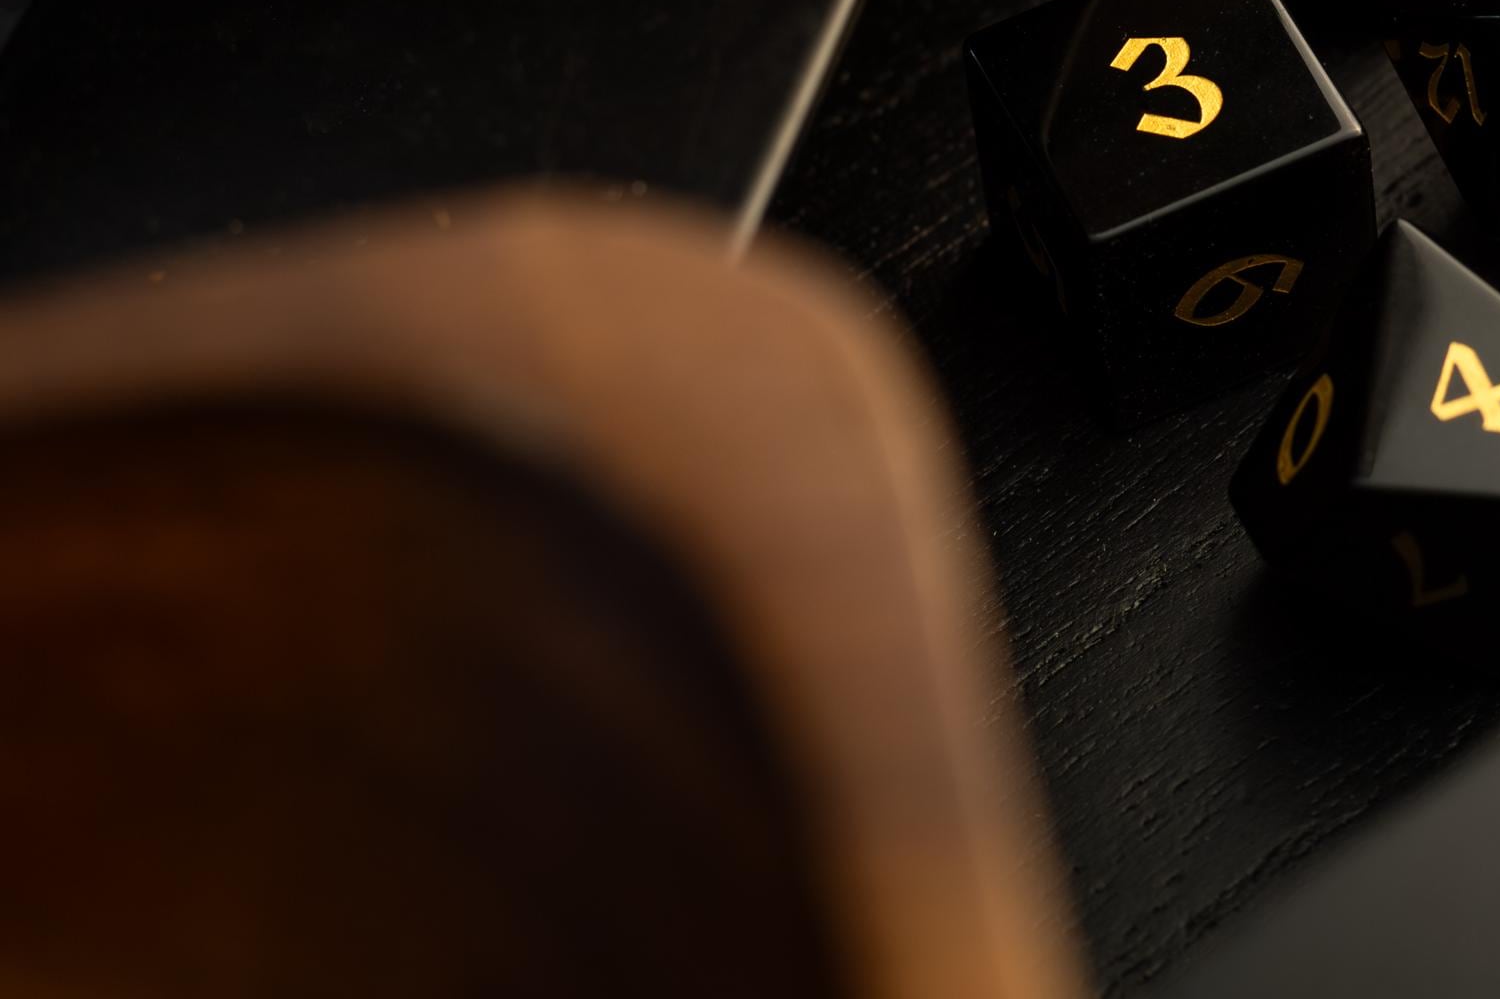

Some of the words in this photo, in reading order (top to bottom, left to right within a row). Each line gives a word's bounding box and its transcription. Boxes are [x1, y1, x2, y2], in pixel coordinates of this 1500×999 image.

[1109, 35, 1225, 141] 3
[1172, 252, 1305, 329] 6
[1275, 374, 1335, 486] 0
